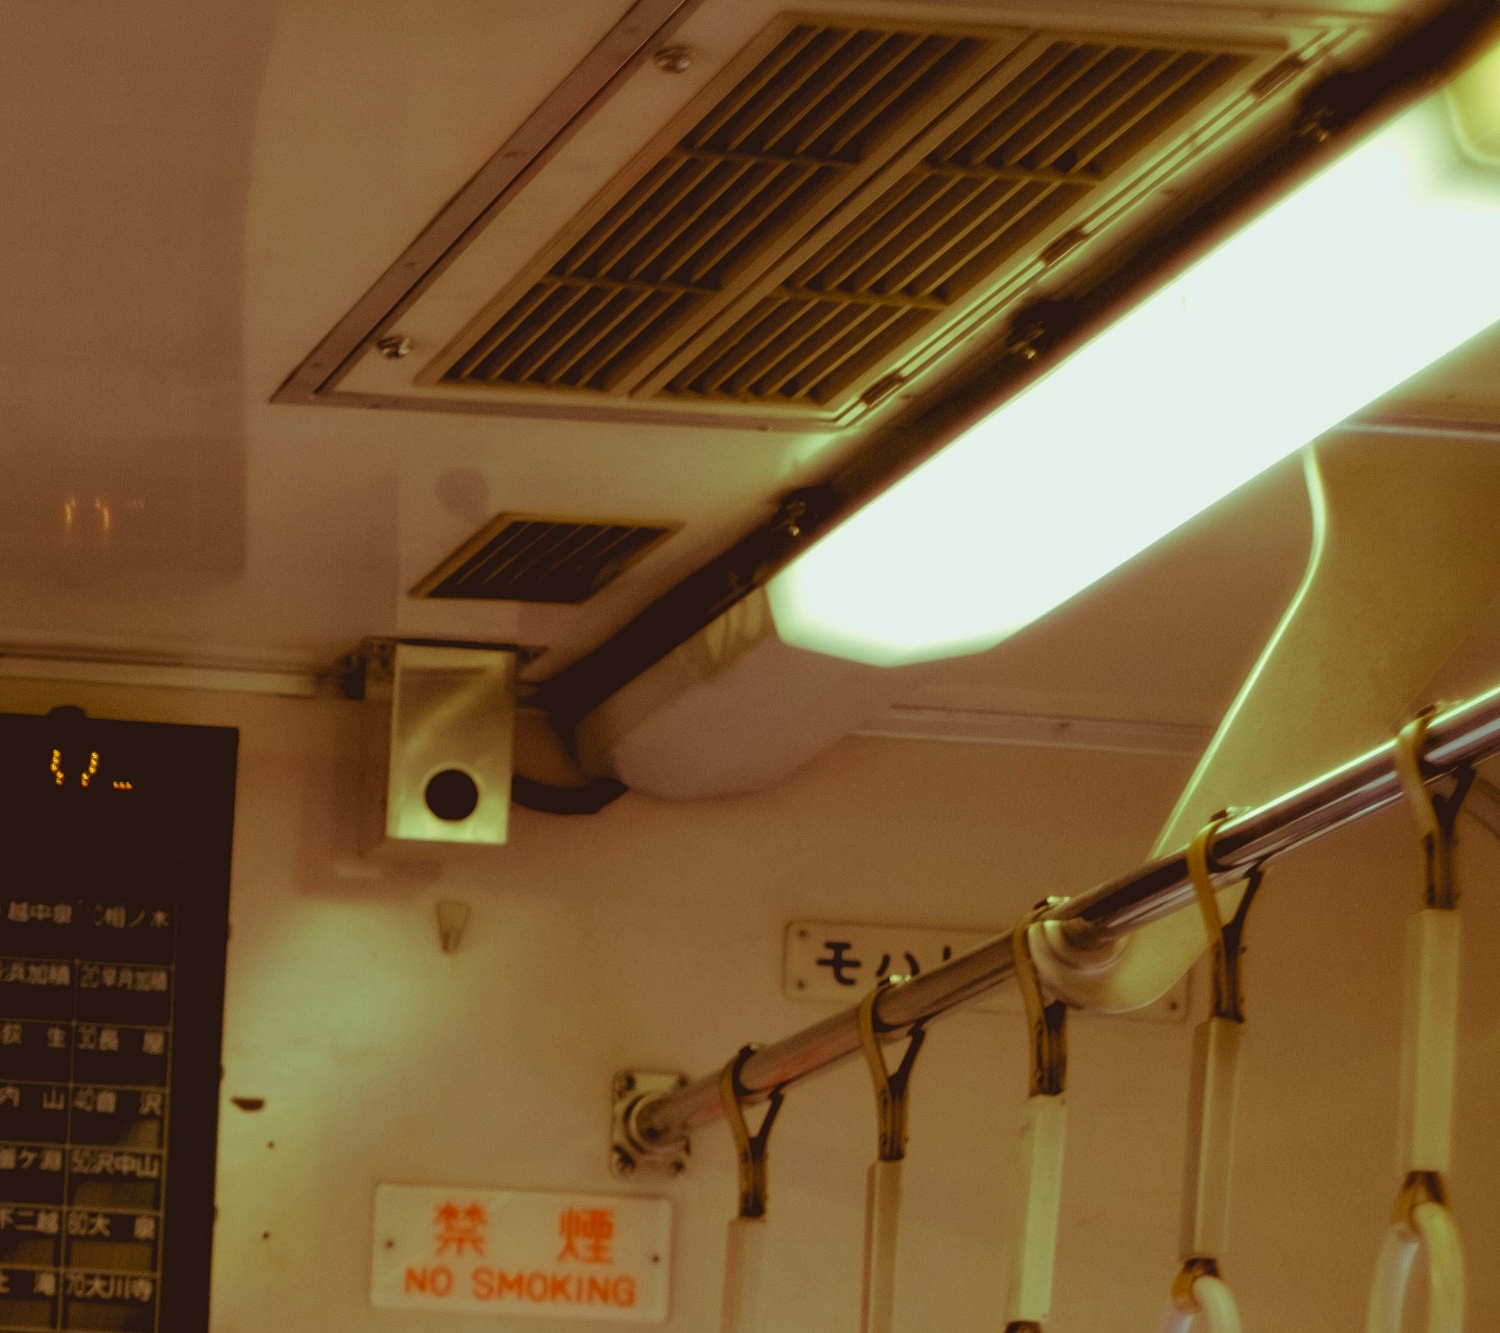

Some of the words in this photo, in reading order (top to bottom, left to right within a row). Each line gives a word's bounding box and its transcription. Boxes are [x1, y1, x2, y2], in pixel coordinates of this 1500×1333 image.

[816, 941, 952, 986] モハ
[404, 1265, 453, 1298] NO
[471, 1266, 638, 1309] SMOKING
